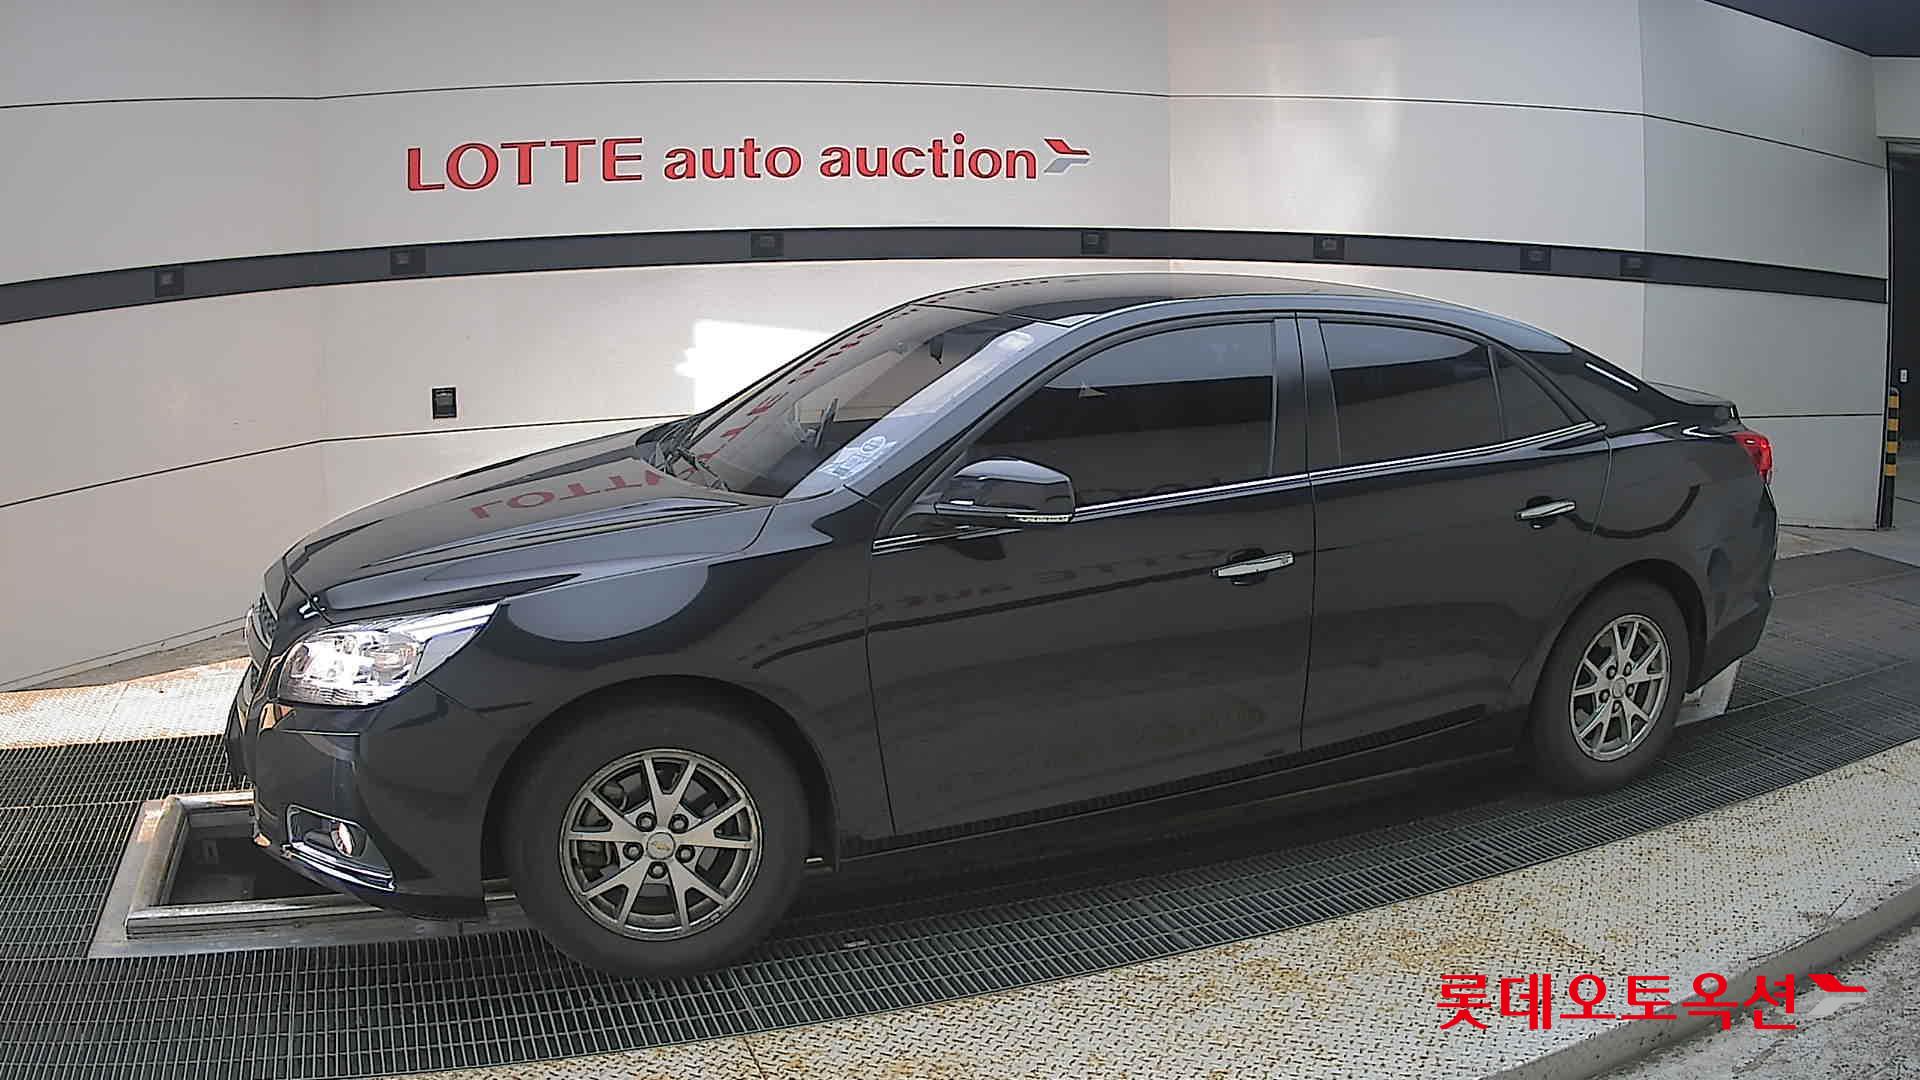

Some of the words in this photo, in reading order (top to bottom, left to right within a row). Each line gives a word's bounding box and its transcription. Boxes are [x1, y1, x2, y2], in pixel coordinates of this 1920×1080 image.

[407, 136, 642, 191] LOTTE
[664, 138, 802, 180] auto
[820, 133, 1038, 180] auction
